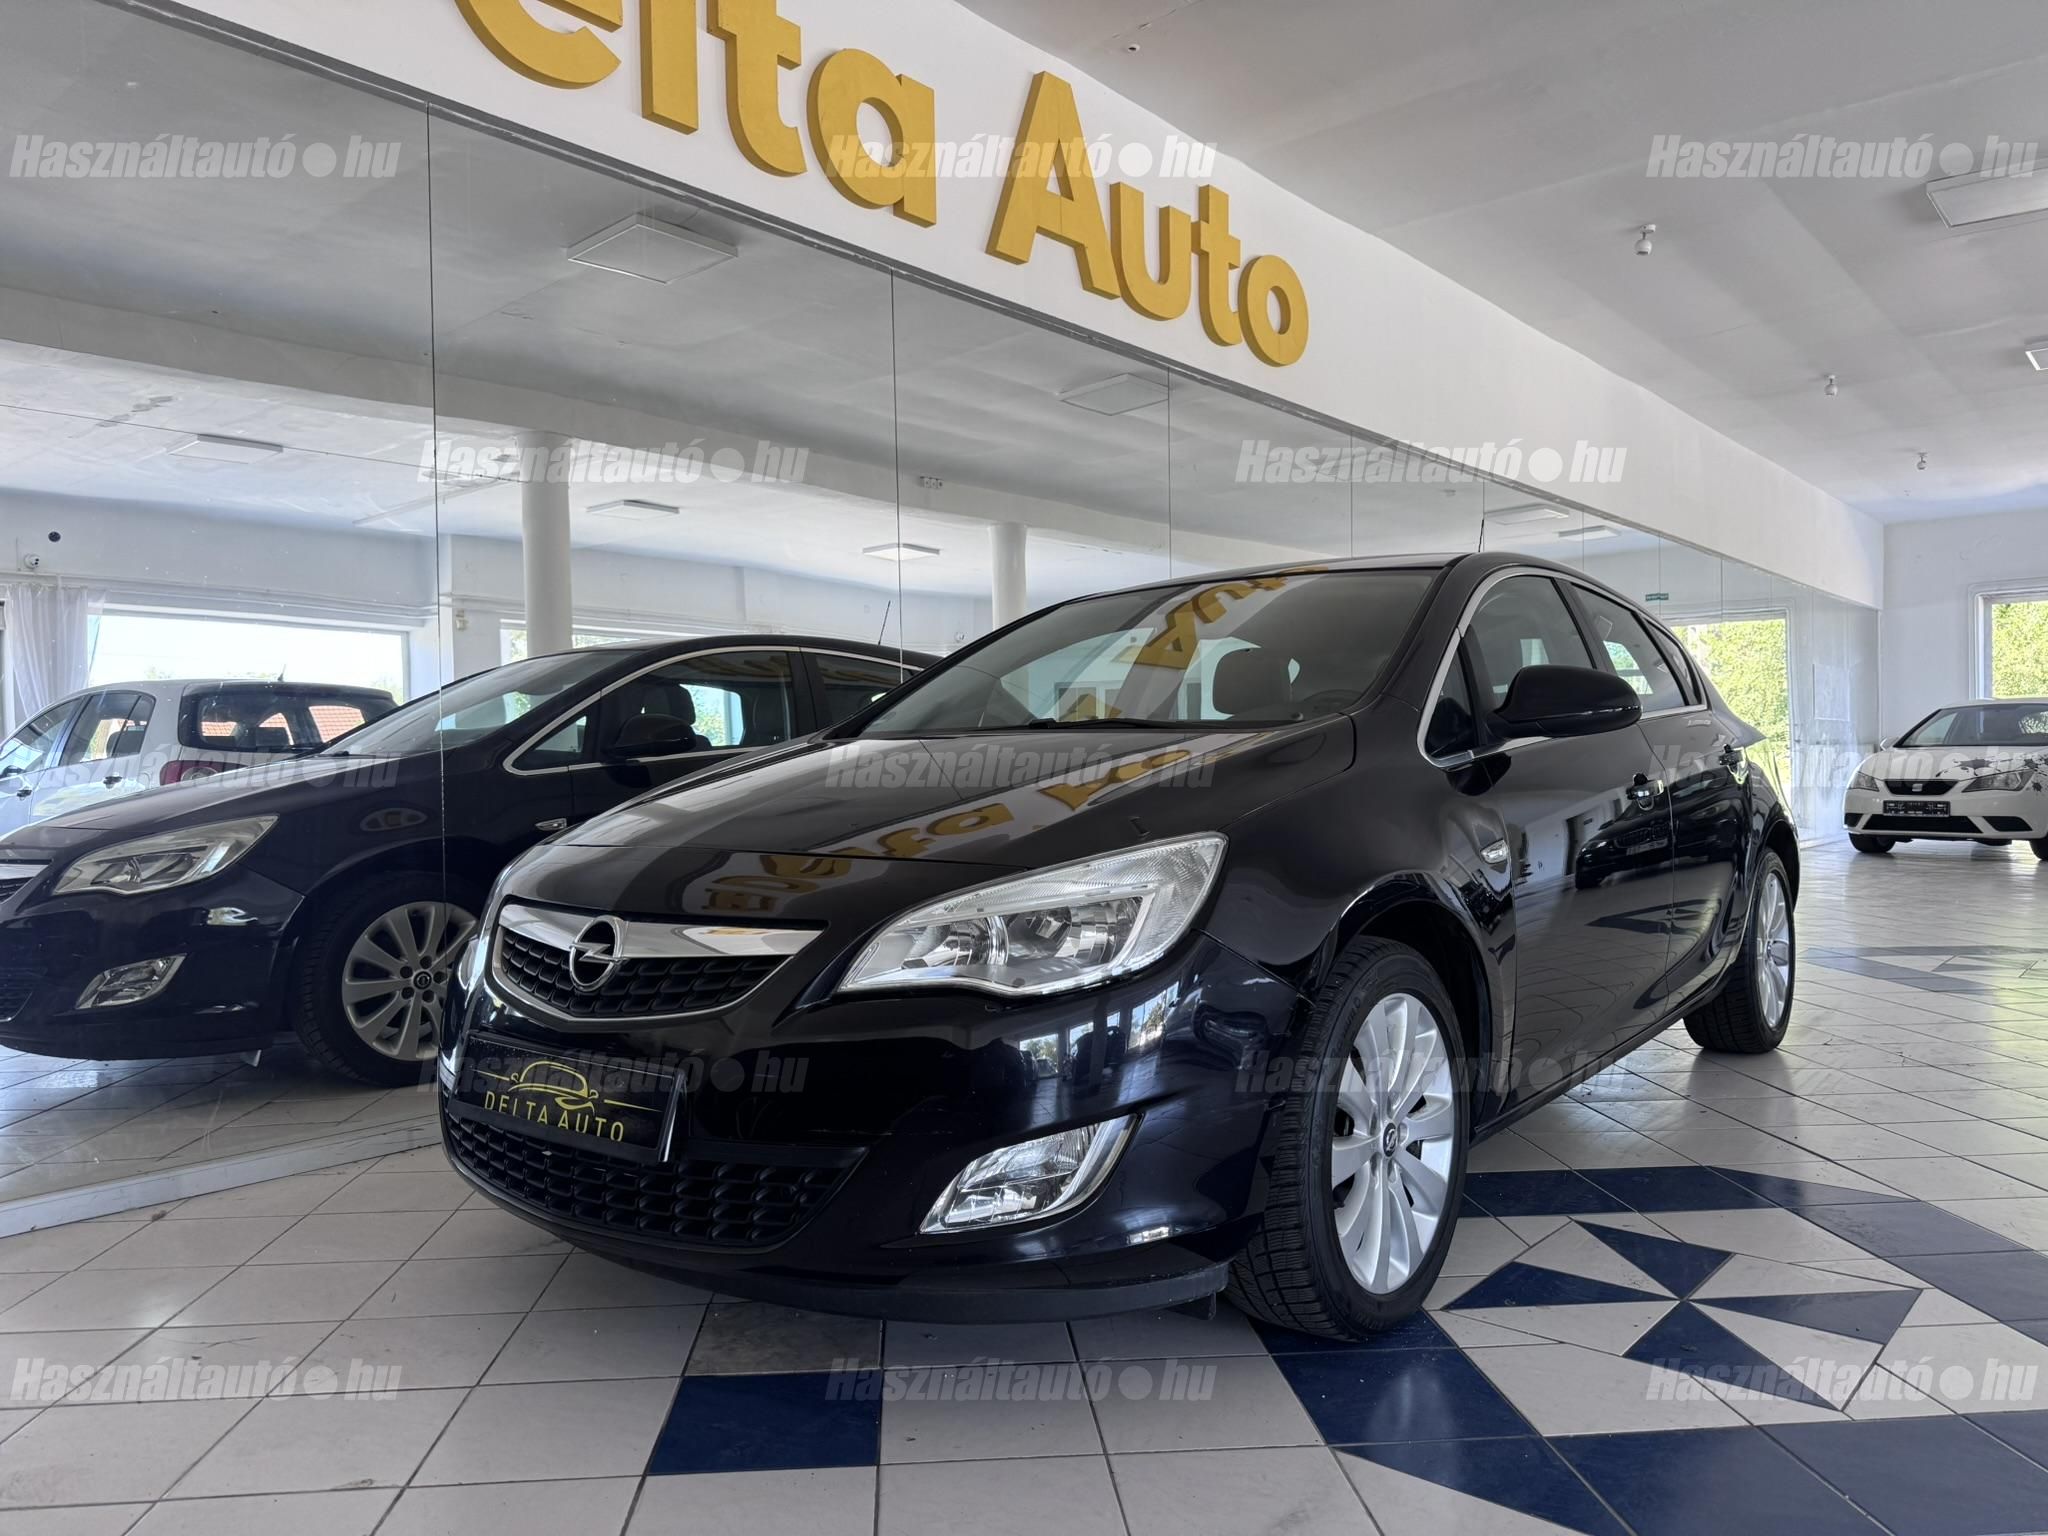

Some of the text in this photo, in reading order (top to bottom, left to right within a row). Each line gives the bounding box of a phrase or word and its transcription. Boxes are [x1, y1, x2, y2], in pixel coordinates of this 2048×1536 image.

[985, 71, 1309, 367] Auto
[484, 1091, 624, 1142] DELTA AUTO
